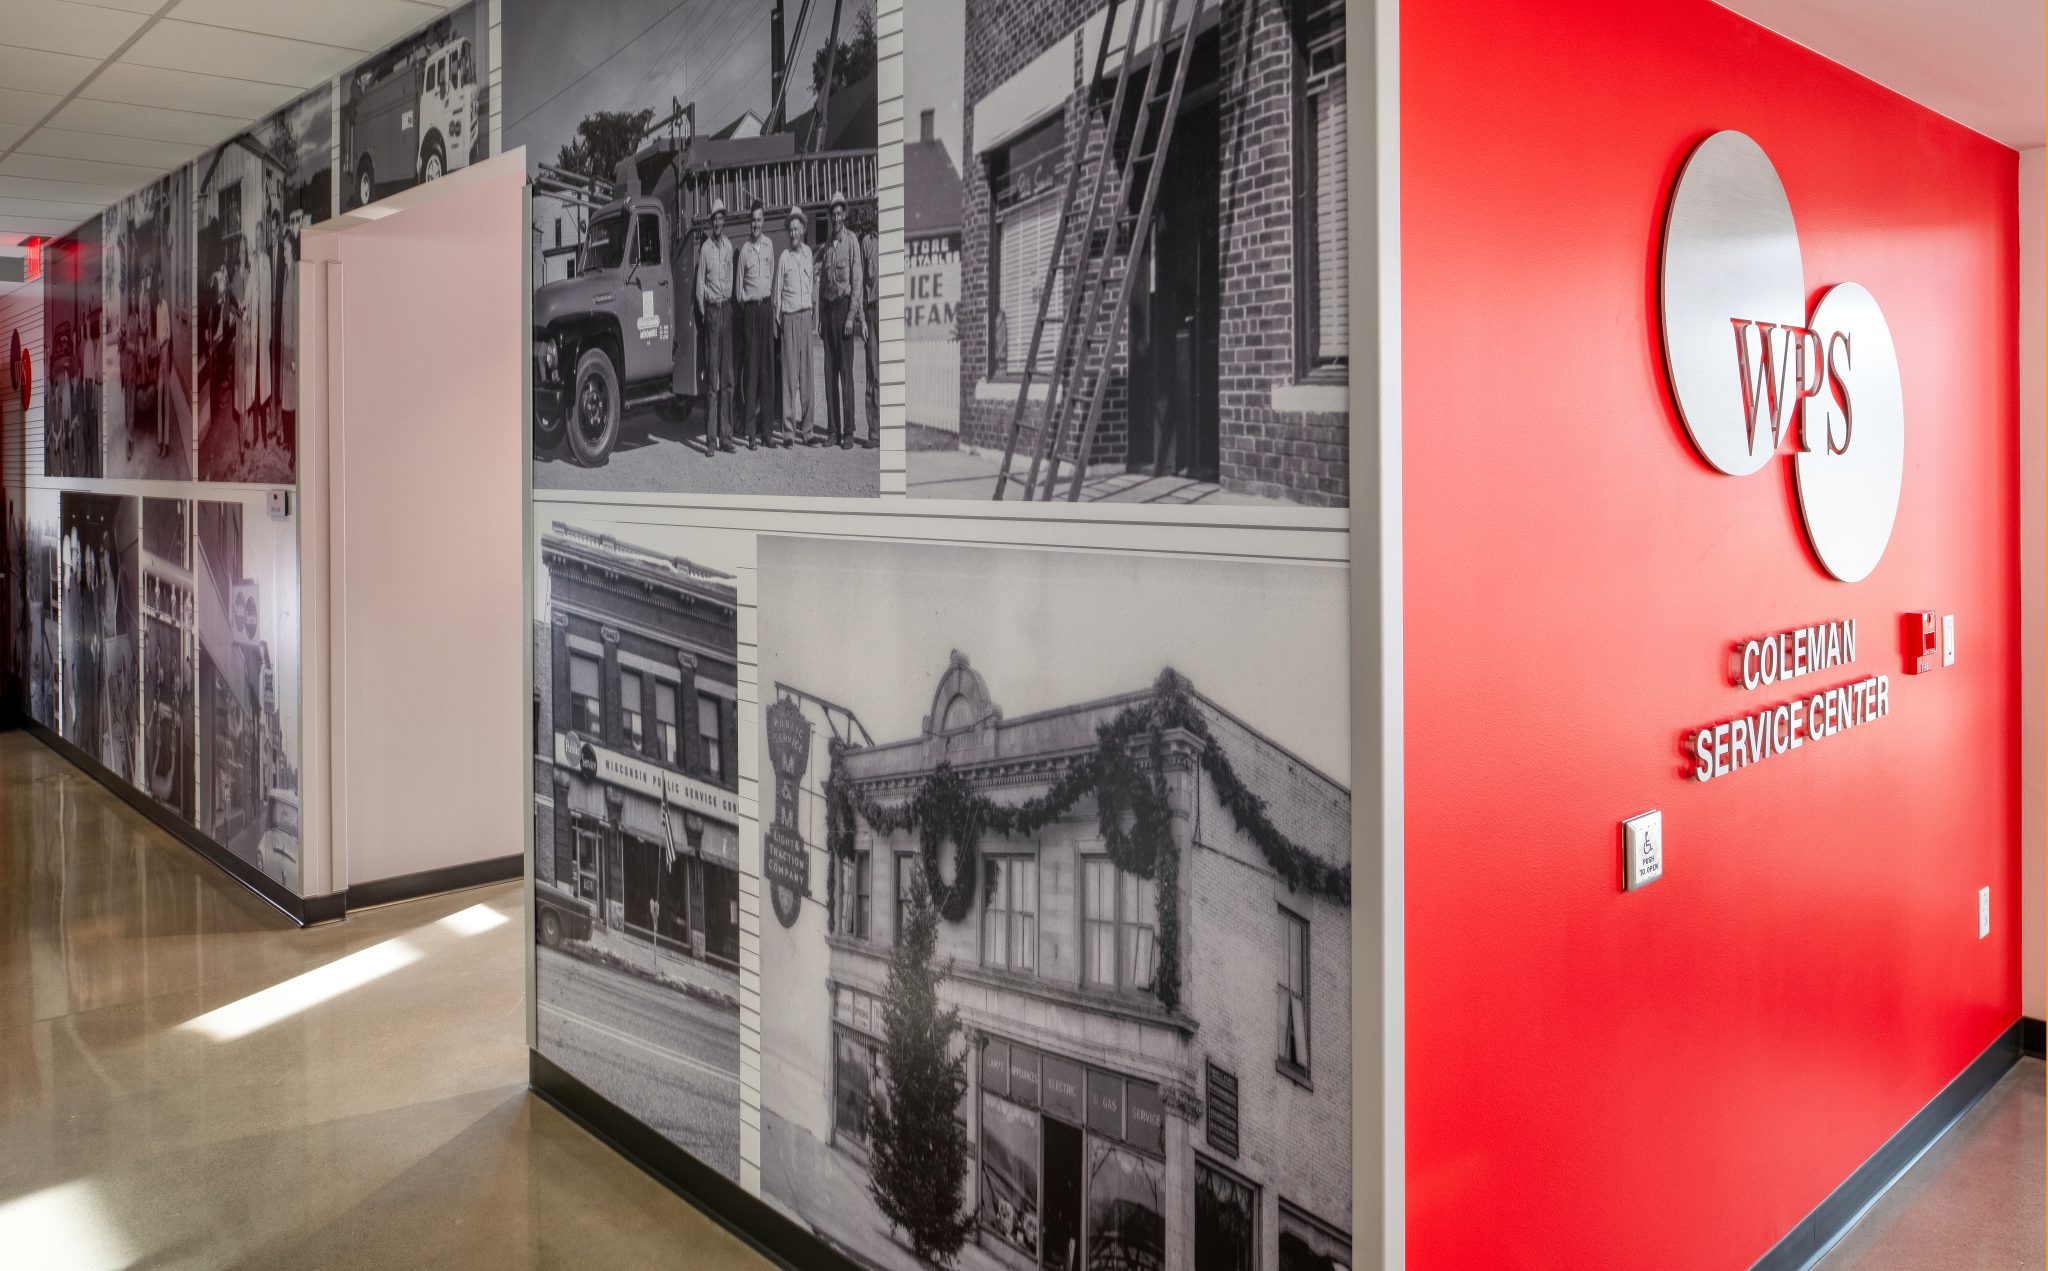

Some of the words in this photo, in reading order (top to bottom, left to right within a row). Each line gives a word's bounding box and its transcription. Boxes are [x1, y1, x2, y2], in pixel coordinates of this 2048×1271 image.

[910, 272, 943, 300] ICE
[1730, 317, 1853, 457] WPS
[1742, 618, 1856, 691] COLEMAN
[773, 718, 803, 738] PUBLIC
[1695, 699, 1803, 782] SERVICE
[1808, 674, 1889, 741] CENTER
[773, 733, 803, 753] SERVICE
[605, 759, 647, 783] WISCONSIN
[652, 774, 680, 794] PULIC
[685, 786, 718, 807] SERVICE
[781, 804, 794, 829] M
[768, 843, 804, 870] TRACTION
[1642, 855, 1655, 866] PUSH
[1647, 862, 1658, 873] OPEN
[768, 859, 804, 886] COMPANY
[1048, 1078, 1076, 1098] ELECTRIC
[1102, 1096, 1117, 1113] GAS
[1131, 1106, 1162, 1128] SERVICE
